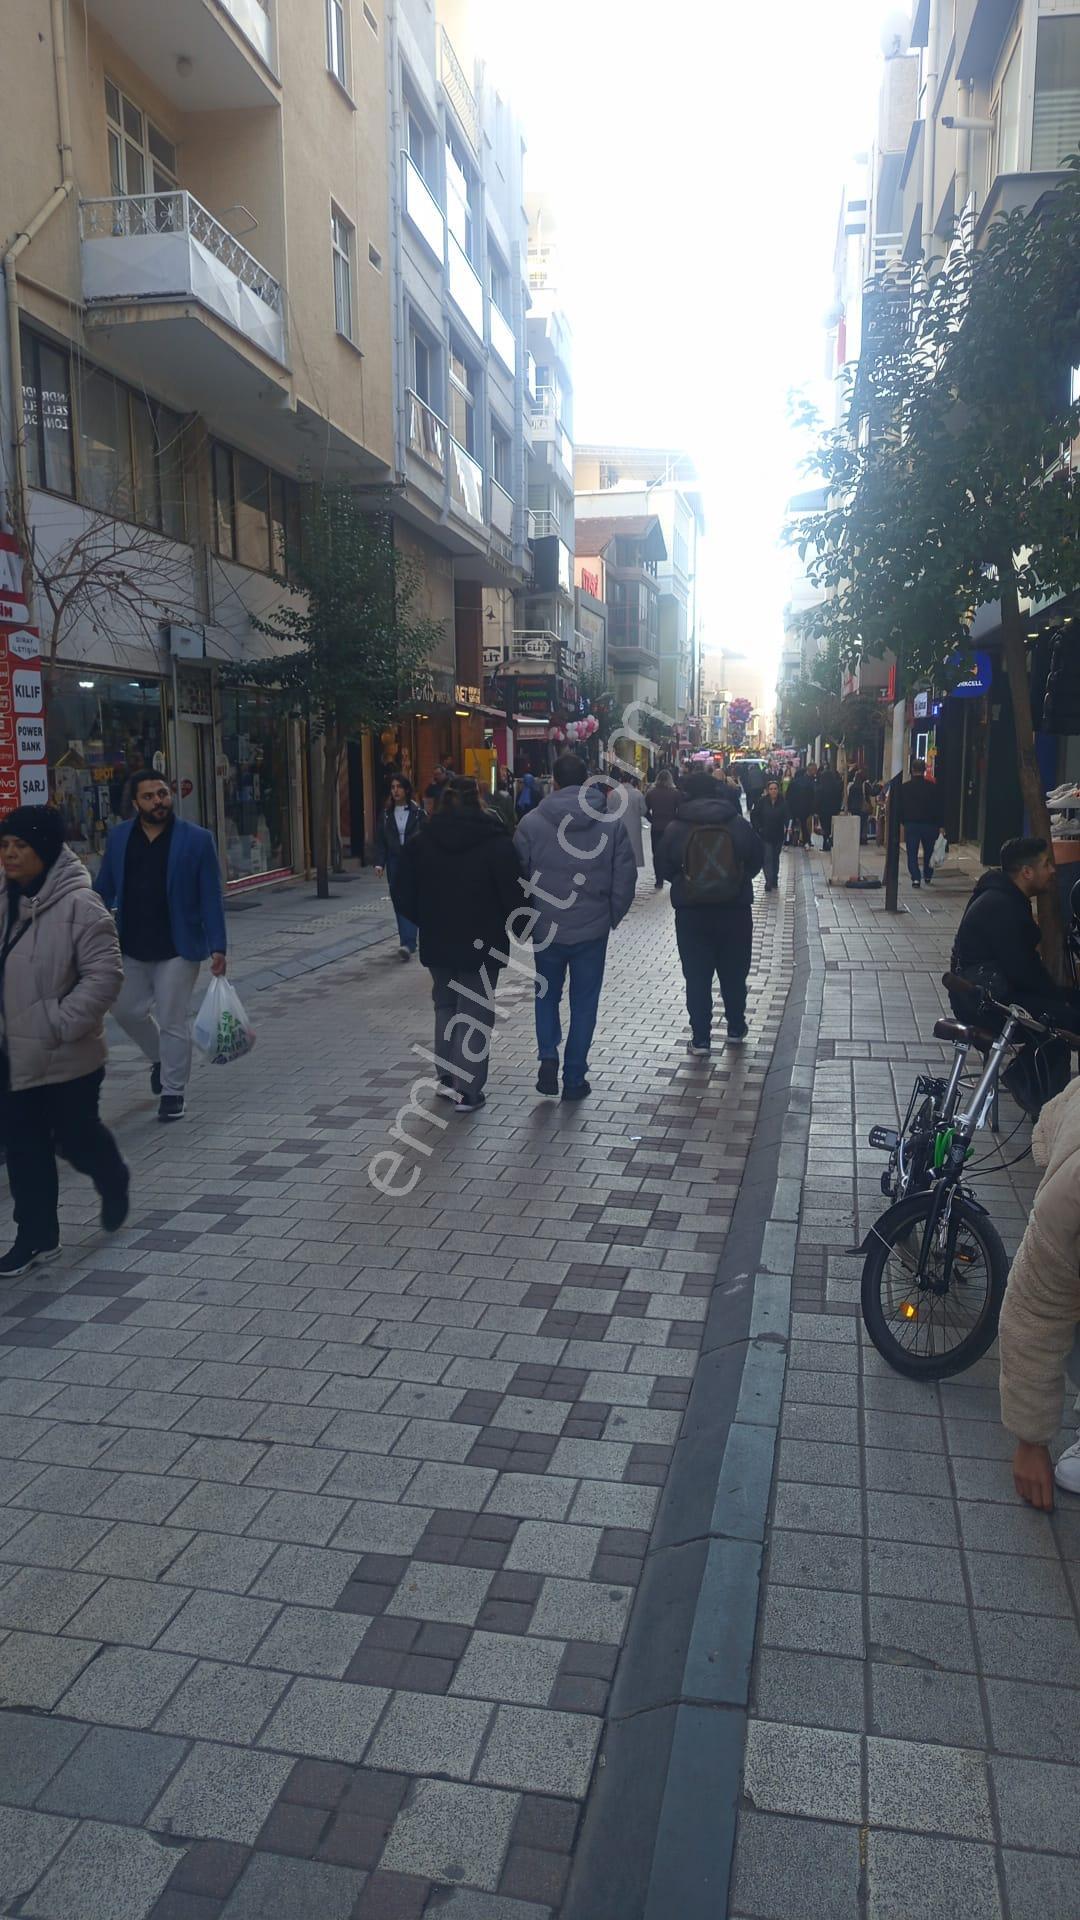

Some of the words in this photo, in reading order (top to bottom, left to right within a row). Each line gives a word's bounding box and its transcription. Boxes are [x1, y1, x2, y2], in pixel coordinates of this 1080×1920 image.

[483, 652, 500, 663] LİT
[15, 684, 40, 700] KILIF
[18, 726, 43, 737] POWER
[21, 741, 41, 752] BANK
[22, 780, 46, 794] ŞARJ
